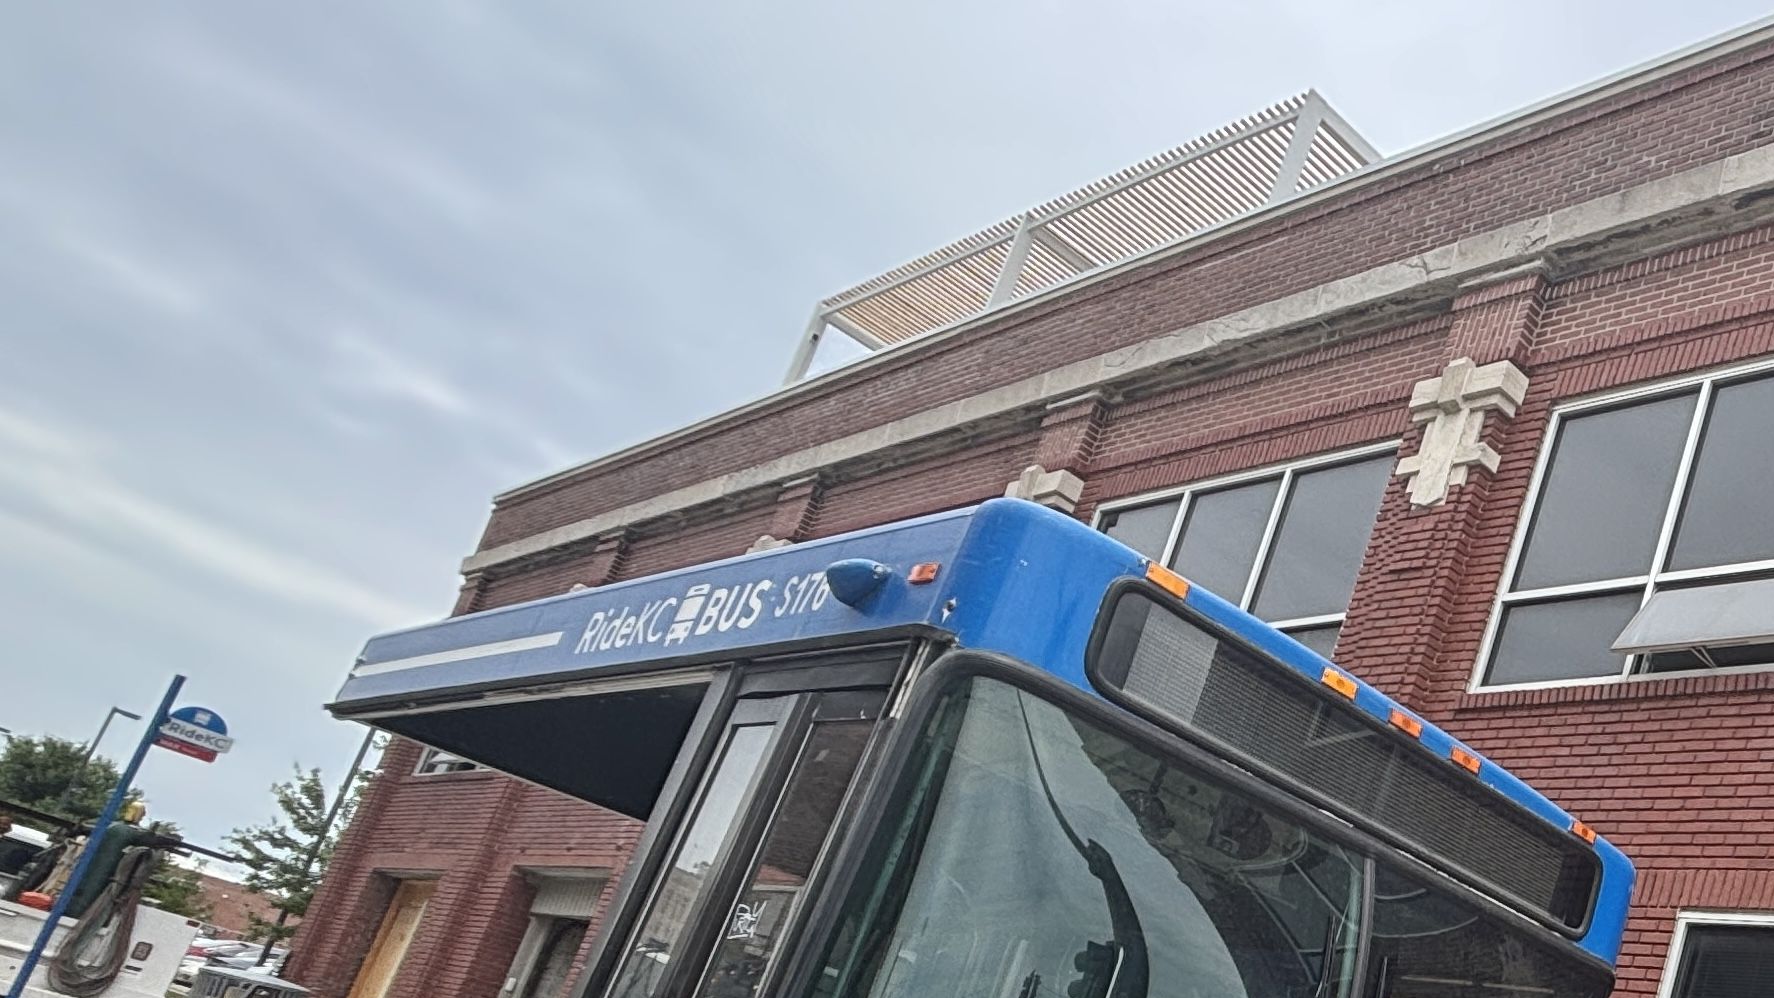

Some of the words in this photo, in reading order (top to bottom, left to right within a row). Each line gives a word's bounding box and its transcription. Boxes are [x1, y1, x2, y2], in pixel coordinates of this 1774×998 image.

[575, 597, 677, 654] RideKC
[695, 579, 772, 635] BUS
[168, 722, 226, 749] RideKC
